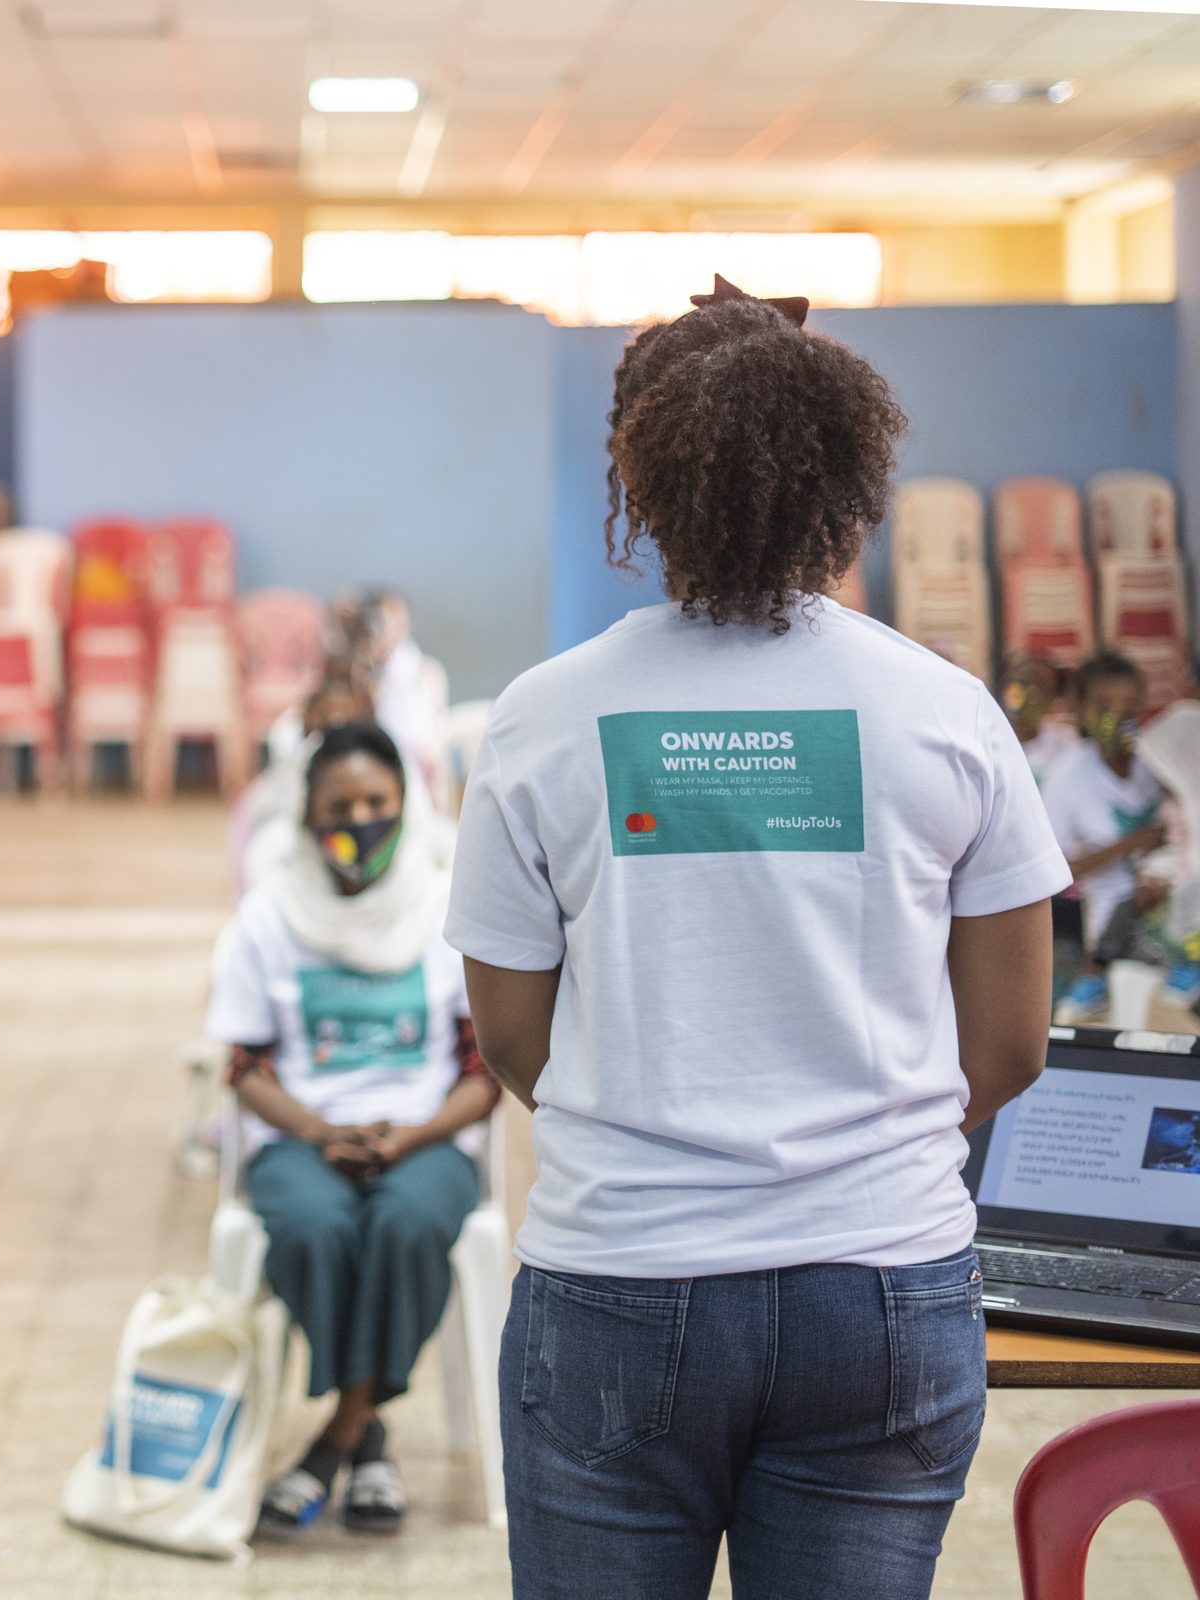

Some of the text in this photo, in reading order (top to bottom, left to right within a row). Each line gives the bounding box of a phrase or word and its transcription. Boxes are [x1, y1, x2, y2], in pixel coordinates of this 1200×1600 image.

[661, 731, 794, 751] ONWARDS
[662, 756, 797, 771] WITH CAUTION
[655, 777, 680, 785] WEAR
[729, 776, 752, 784] KEEP
[753, 776, 767, 784] MY
[659, 788, 685, 797] WASH
[686, 788, 699, 796] MY
[739, 787, 757, 796] GET
[766, 816, 842, 831] #ItsUpToUs
